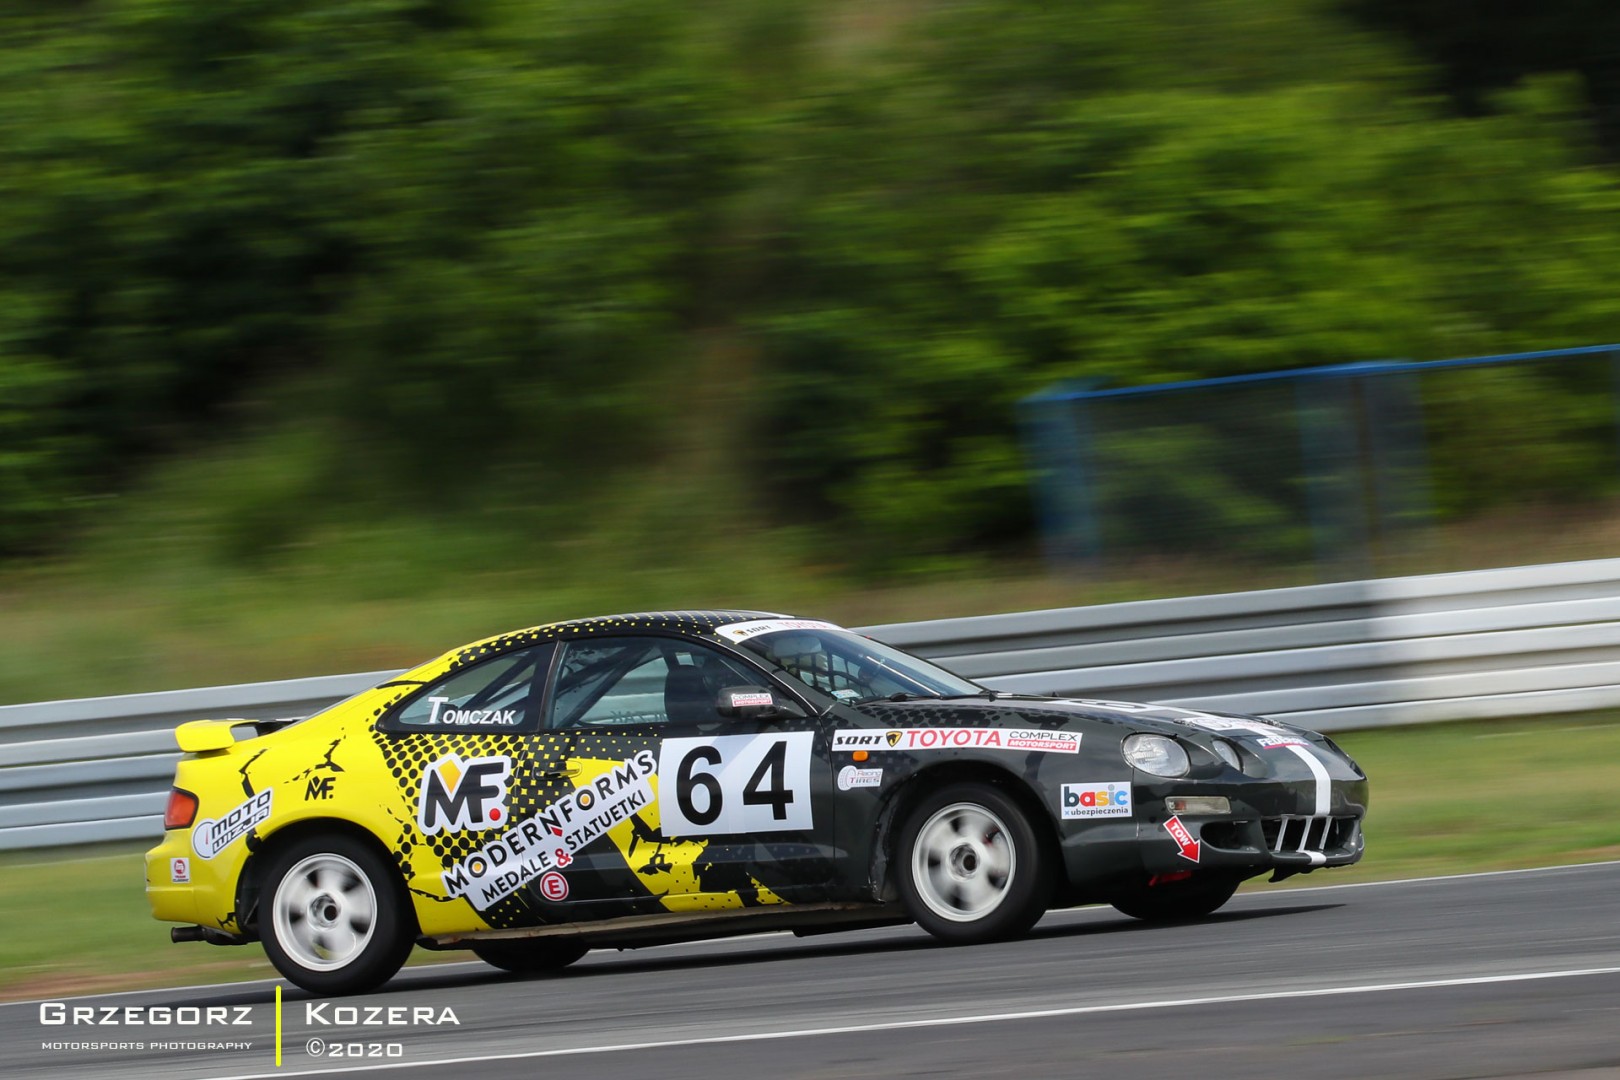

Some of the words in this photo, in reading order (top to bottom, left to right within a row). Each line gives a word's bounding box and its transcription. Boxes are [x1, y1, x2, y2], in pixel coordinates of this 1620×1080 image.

[428, 696, 516, 725] TOMCZAK
[834, 735, 884, 746] SORT
[907, 730, 1002, 747] TOYOTA
[1009, 740, 1076, 750] MOTORSPORT
[1010, 731, 1078, 741] COMPLEX
[676, 741, 794, 826] 64
[1064, 784, 1128, 807] basic
[212, 790, 271, 840] MOTO
[1071, 807, 1129, 817] ubezpieczenia
[444, 754, 654, 895] MODERNFORMS
[1171, 822, 1191, 847] TOW
[481, 852, 552, 903] MEDALE
[555, 848, 572, 867] &
[565, 789, 646, 851] STATUETKI
[548, 879, 561, 895] E
